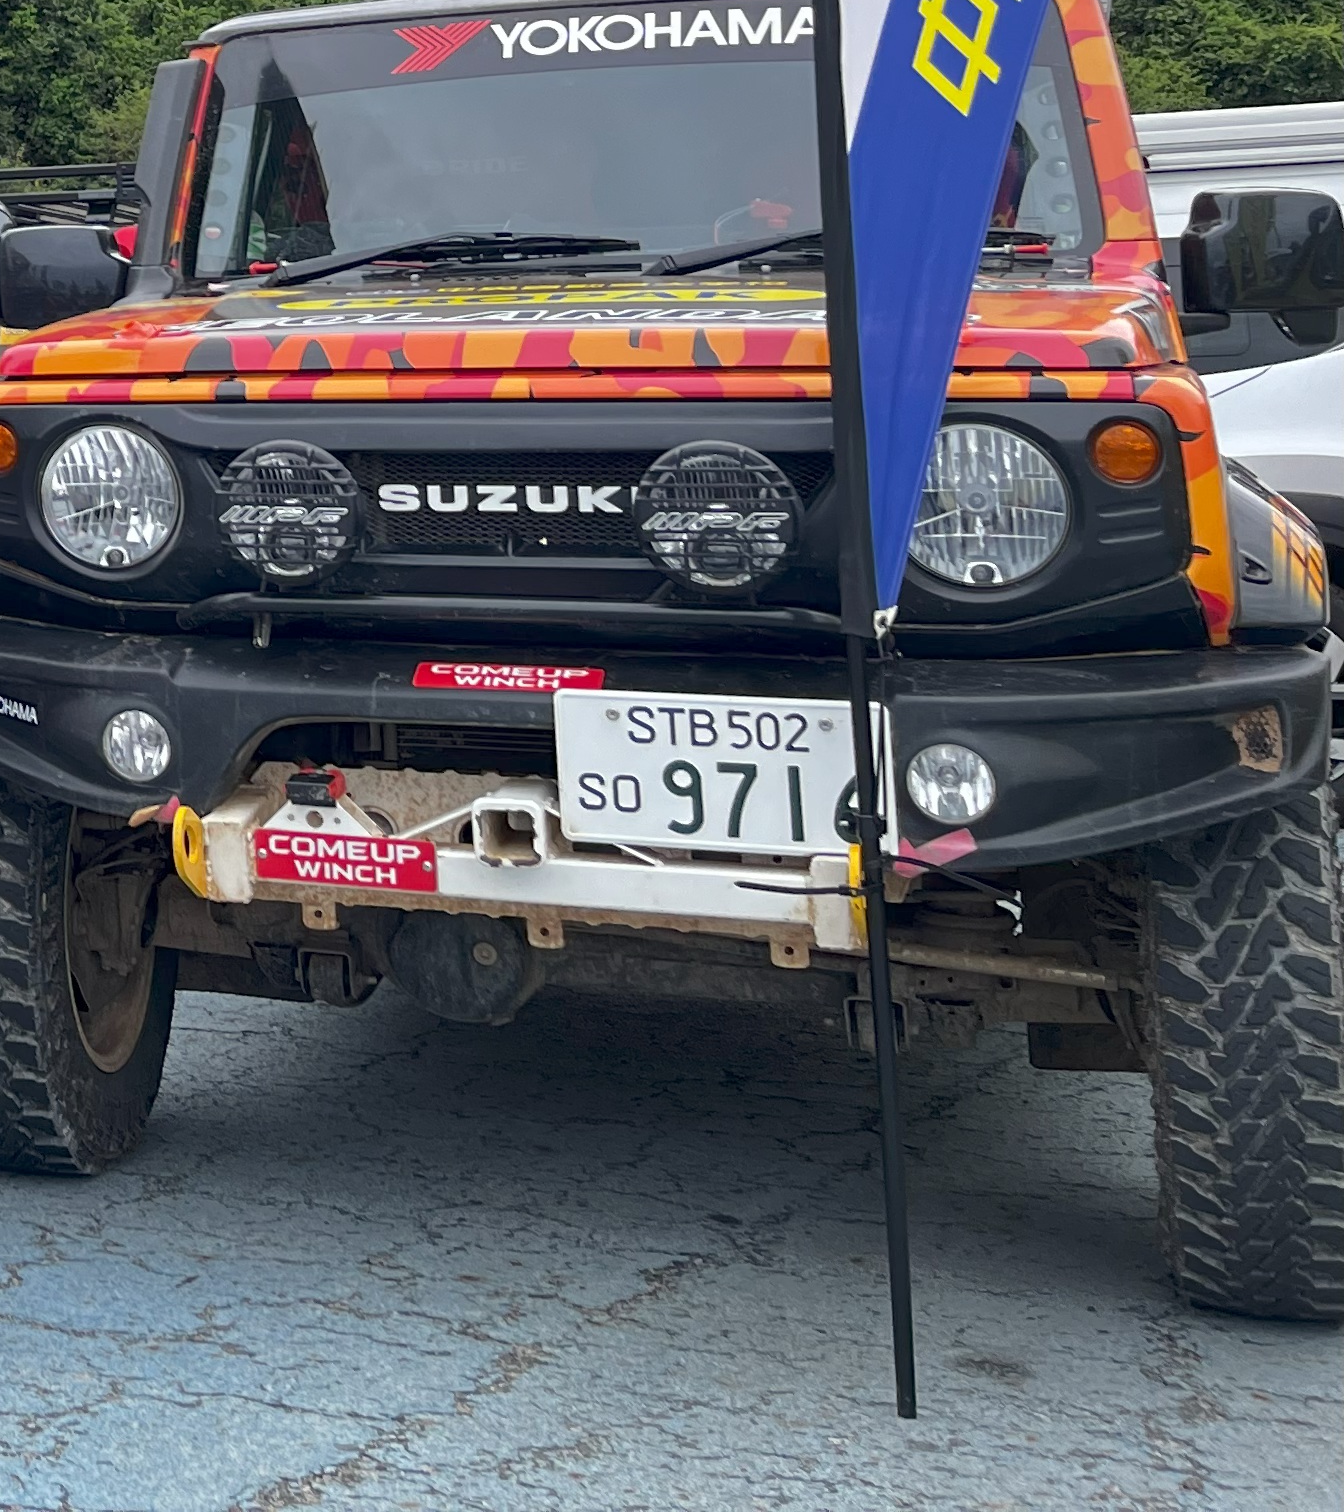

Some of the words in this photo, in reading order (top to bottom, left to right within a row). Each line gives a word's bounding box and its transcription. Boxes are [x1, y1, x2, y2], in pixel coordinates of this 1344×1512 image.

[491, 7, 817, 59] YOKOHAMA
[327, 290, 761, 308] PROPAK
[378, 484, 638, 514] SUZUK
[430, 664, 590, 679] COMEUP
[454, 674, 561, 689] WINCH
[627, 705, 719, 748] STB
[727, 709, 811, 753] 502
[268, 835, 422, 865] COMEUP
[293, 859, 398, 886] WINCH
